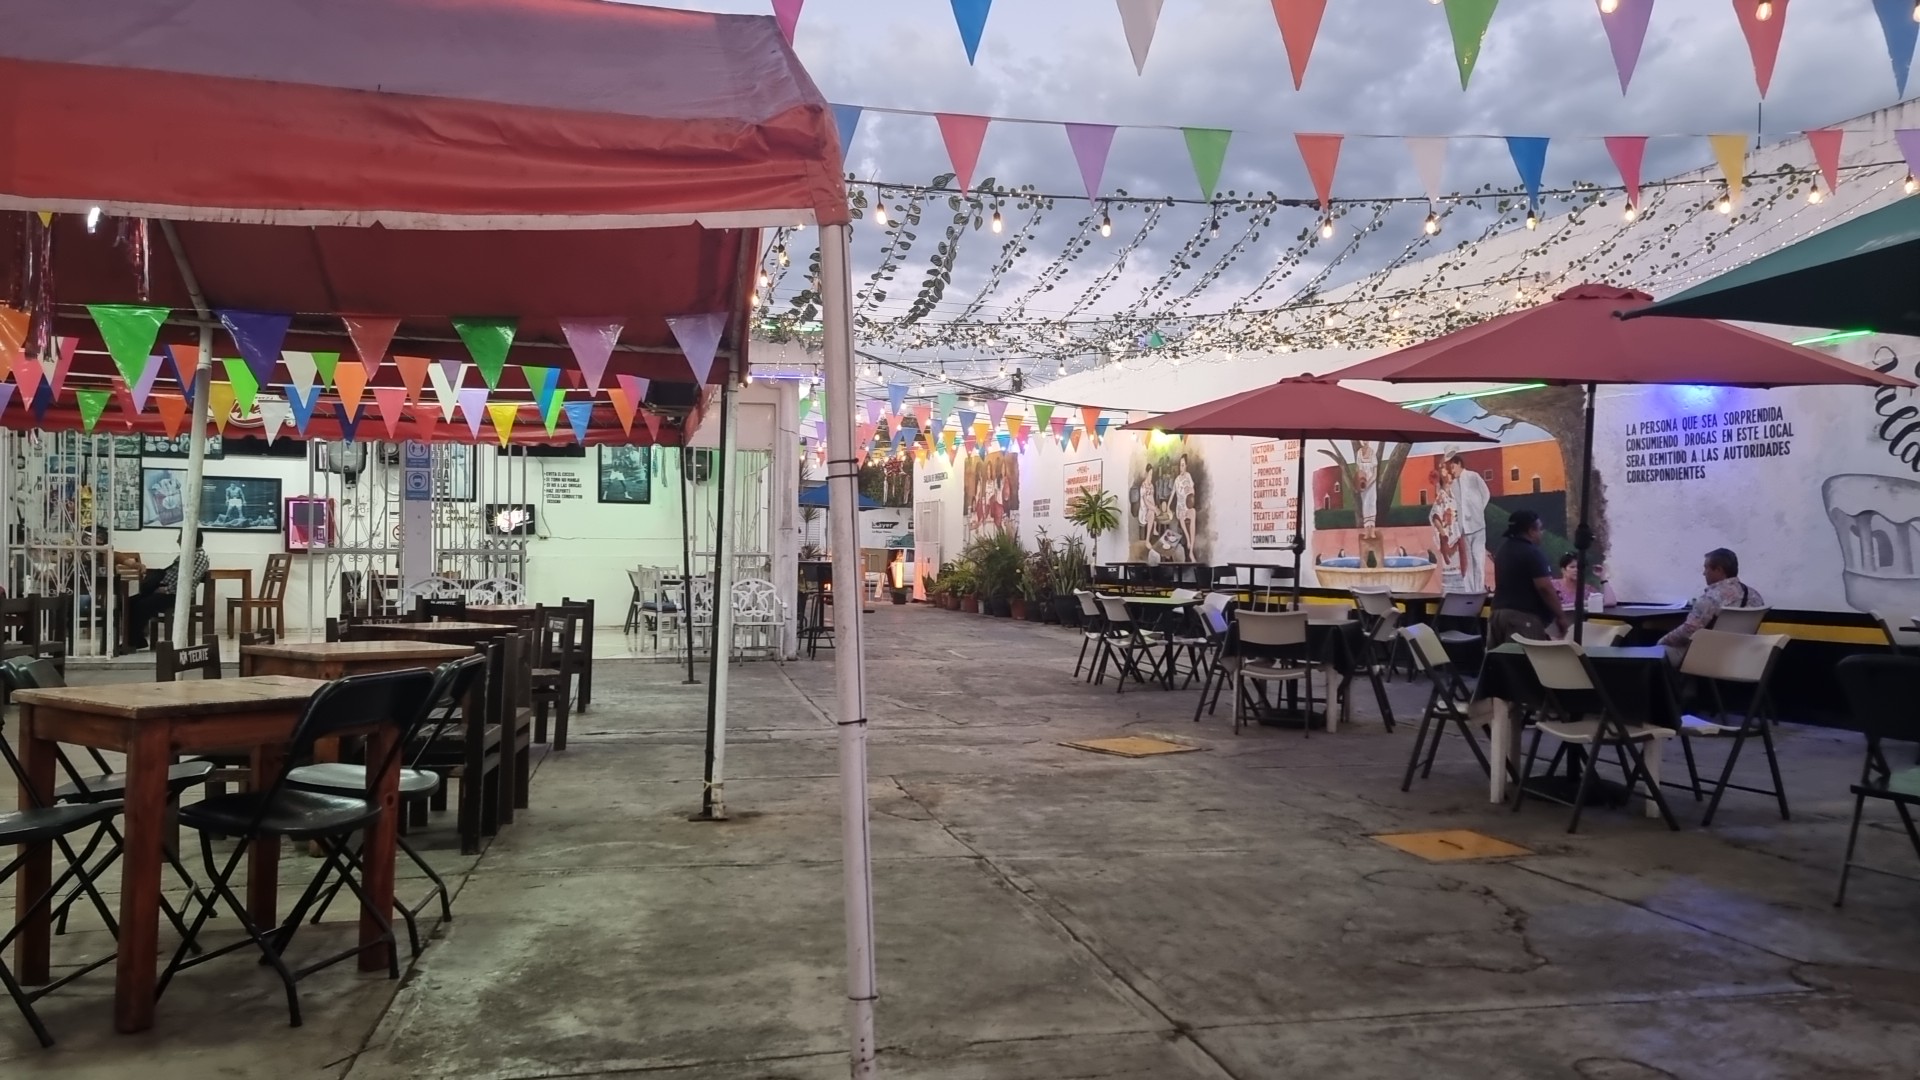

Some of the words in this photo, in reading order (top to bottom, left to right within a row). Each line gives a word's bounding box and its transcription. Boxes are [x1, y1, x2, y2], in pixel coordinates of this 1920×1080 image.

[1626, 423, 1637, 436] LA
[1640, 417, 1679, 435] PERSONA
[1682, 415, 1698, 432] QUE
[1702, 413, 1718, 429] SEA
[1723, 406, 1783, 426] SORPRENDIDA
[1626, 434, 1679, 452] CONSUMIENDO
[1684, 430, 1717, 447] DROGAS
[1722, 428, 1733, 443] EN
[1736, 425, 1759, 442] ESTE
[1763, 422, 1794, 439] LOCAL
[1252, 443, 1275, 455] VICTORIA
[1626, 454, 1646, 468] SERA
[1649, 450, 1687, 467] REMITIDO
[1691, 450, 1698, 463] A
[1701, 447, 1719, 463] LAS
[1723, 441, 1791, 461] AUTORIDADES
[1252, 455, 1268, 465] ULTRA
[1626, 464, 1706, 484] CORRESPONDIENTES
[1253, 477, 1282, 488] CUBETAZOS
[1283, 476, 1289, 486] 10
[1253, 489, 1279, 499] CUARTITAS
[1280, 488, 1287, 497] DE
[1253, 501, 1263, 510] SOL
[1253, 511, 1271, 520] TECATE
[1271, 511, 1285, 520] LIGHT
[1253, 522, 1259, 532] XX
[1260, 522, 1275, 531] LAGER
[1253, 534, 1277, 544] CORONITA
[188, 648, 209, 663] TECATE
